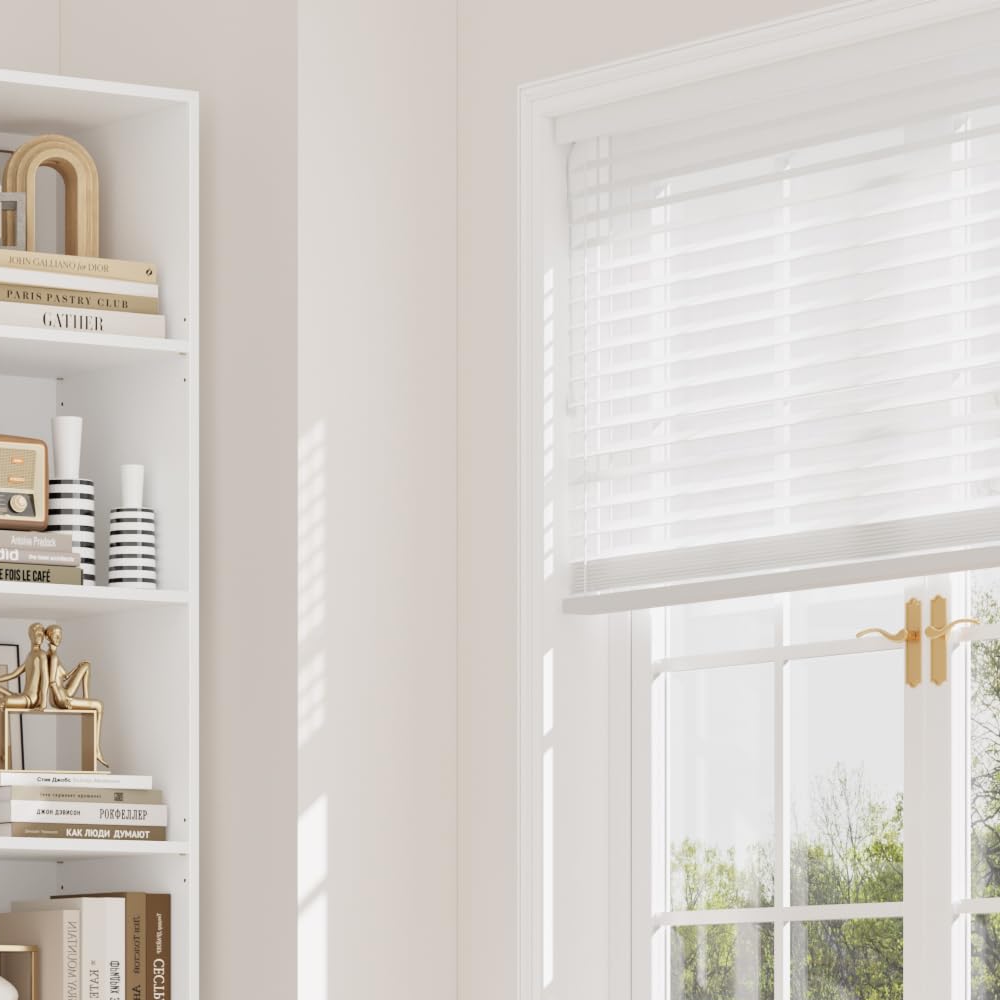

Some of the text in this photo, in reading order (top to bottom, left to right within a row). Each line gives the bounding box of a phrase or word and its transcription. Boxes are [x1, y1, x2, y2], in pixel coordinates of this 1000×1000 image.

[8, 255, 30, 265] JOHN
[33, 257, 76, 270] GALLIANO
[88, 264, 109, 273] DIOR
[6, 290, 128, 309] PARIS PASTRY CLUB
[42, 312, 104, 332] GATHER
[5, 568, 20, 582] FOIS
[22, 568, 31, 582] LE
[32, 568, 51, 583] CAFÉ
[37, 807, 80, 817] ДЖОН ДЭВИСОН
[99, 807, 148, 821] РОКФЕЛЛЕР
[66, 828, 83, 838] КАК
[84, 829, 110, 840] ЛЮДИ
[113, 830, 150, 840] ДУМАЮТ
